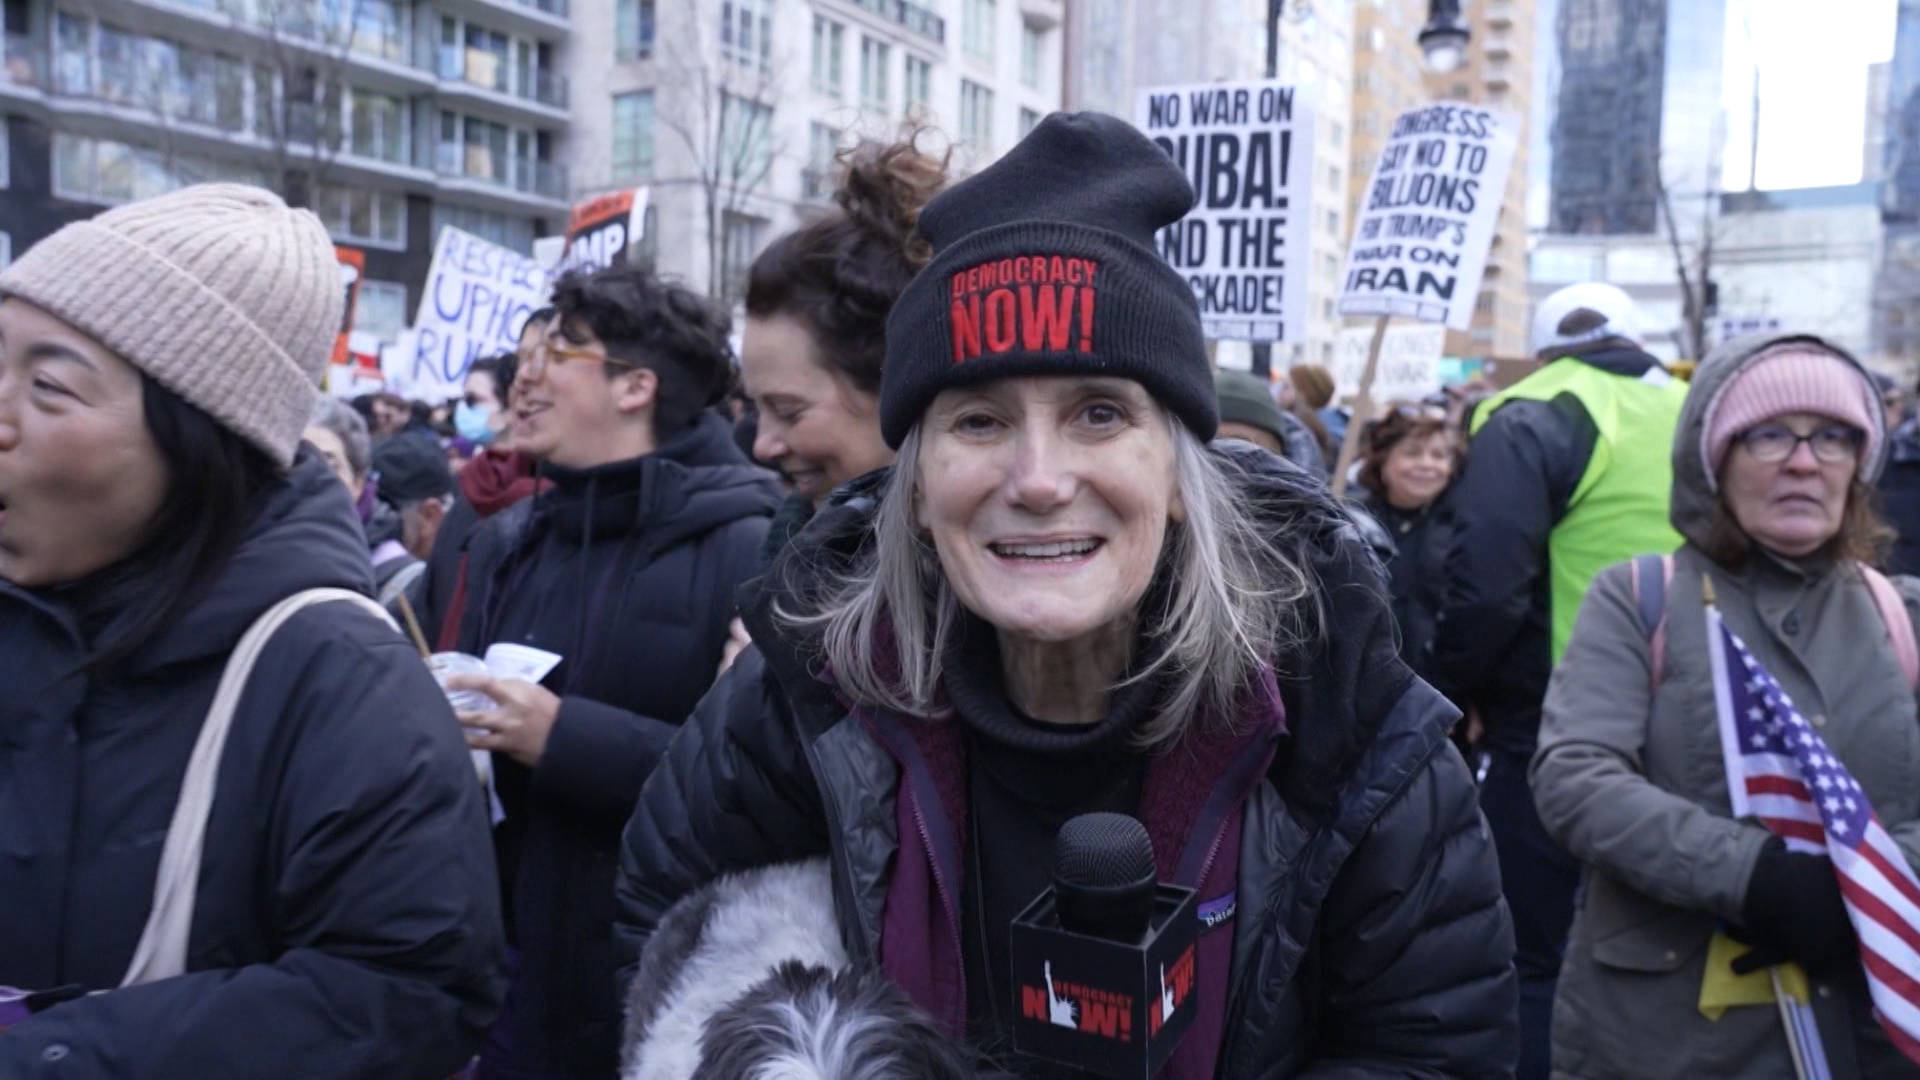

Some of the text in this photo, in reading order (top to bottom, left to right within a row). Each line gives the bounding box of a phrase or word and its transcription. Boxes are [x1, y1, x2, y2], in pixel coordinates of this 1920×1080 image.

[1148, 86, 1294, 129] NO WAR ON
[1414, 138, 1446, 168] NO
[1456, 142, 1487, 175] TO
[1159, 217, 1286, 269] ND THE
[1408, 246, 1460, 269] ON
[953, 255, 1097, 298] DEMOCRACY
[1187, 273, 1283, 315] CKADE!
[1344, 266, 1456, 301] IRAN
[434, 272, 532, 346] UPHO
[951, 284, 1096, 364] NOW!
